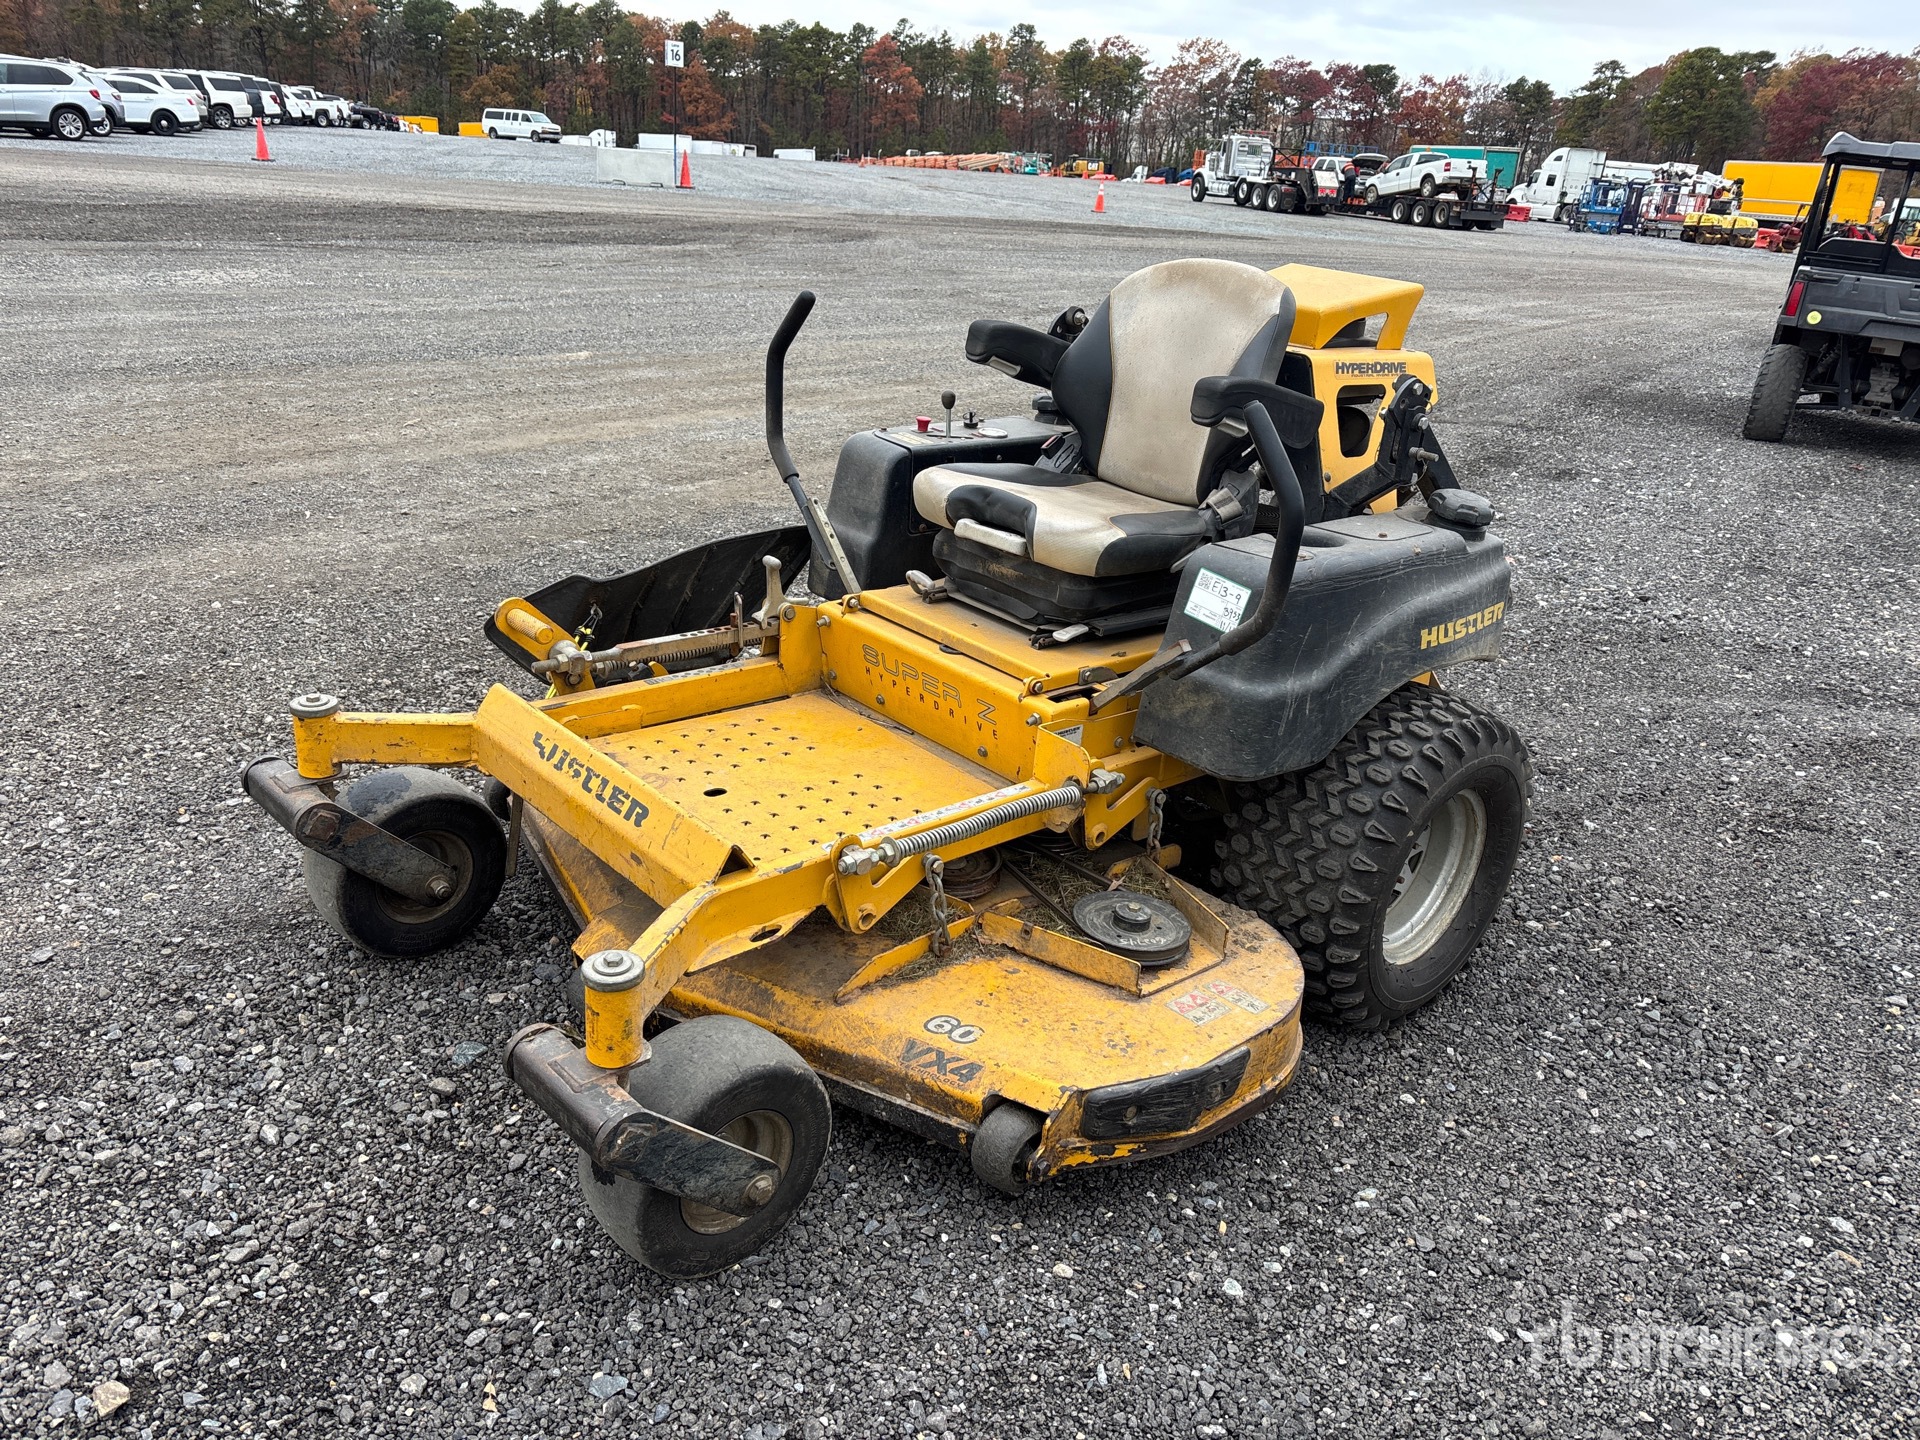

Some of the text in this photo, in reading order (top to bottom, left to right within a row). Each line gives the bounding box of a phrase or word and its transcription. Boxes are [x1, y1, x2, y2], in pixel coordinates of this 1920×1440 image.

[670, 49, 681, 61] 16
[1335, 361, 1407, 375] HYPERDRIVE
[1211, 580, 1242, 605] E13-9
[1420, 601, 1505, 650] HUSTLER
[862, 643, 997, 725] SUPER Z
[865, 665, 998, 740] HYPERDRIVE
[923, 1014, 985, 1044] 60
[900, 1039, 984, 1083] VX4
